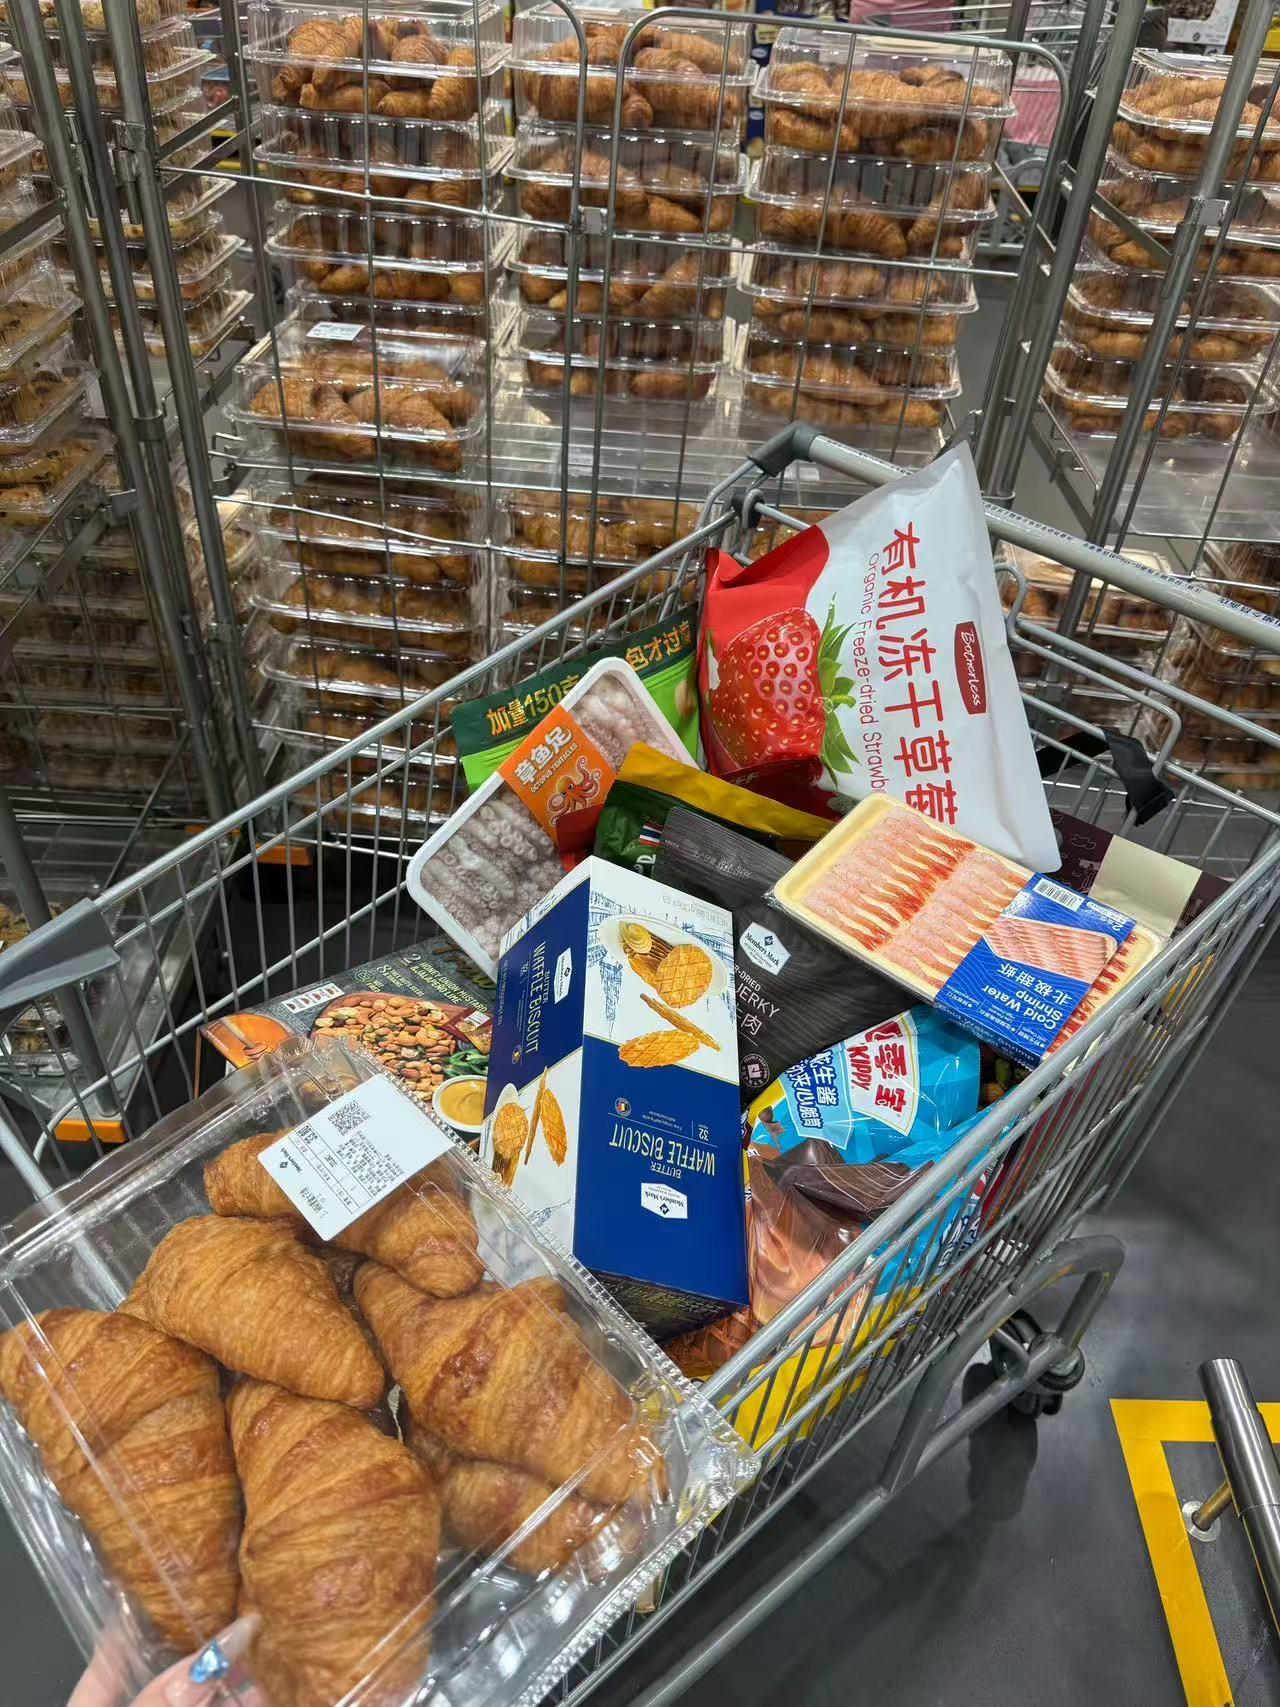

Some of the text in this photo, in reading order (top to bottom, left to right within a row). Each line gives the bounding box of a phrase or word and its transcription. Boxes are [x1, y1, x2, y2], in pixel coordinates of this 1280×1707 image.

[860, 552, 880, 614] Organic
[852, 619, 872, 725] Freeze-dried
[876, 521, 959, 825] 有机冻干草莓
[961, 628, 981, 706] Botherless
[514, 726, 573, 786] 章鱼足
[530, 742, 578, 793] OCTOPUS TENTACLES
[403, 953, 421, 965] 2
[745, 932, 768, 958] Member's
[766, 951, 781, 967] Mark
[419, 961, 440, 980] HONEY
[438, 976, 461, 995] ONION
[457, 989, 488, 1013] MUSTARD
[525, 941, 546, 1054] WAFFLE BISCUIT
[734, 963, 761, 992] R-DRIED
[997, 963, 1073, 1006] 北极甜虾
[736, 982, 780, 1018] JERKY
[981, 984, 1057, 1030] Cold Water
[1015, 990, 1063, 1021] Shrimp
[963, 1018, 994, 1039] Water
[998, 1036, 1034, 1061] Shrimp
[847, 1042, 872, 1091] KIPPY
[298, 1124, 318, 1144] 33.80
[609, 1123, 715, 1177] WAFFLE BISCUIT
[698, 1127, 709, 1141] 32
[650, 1161, 682, 1179] BUTTER
[644, 1190, 659, 1200] Mark
[658, 1195, 685, 1208] Member's
